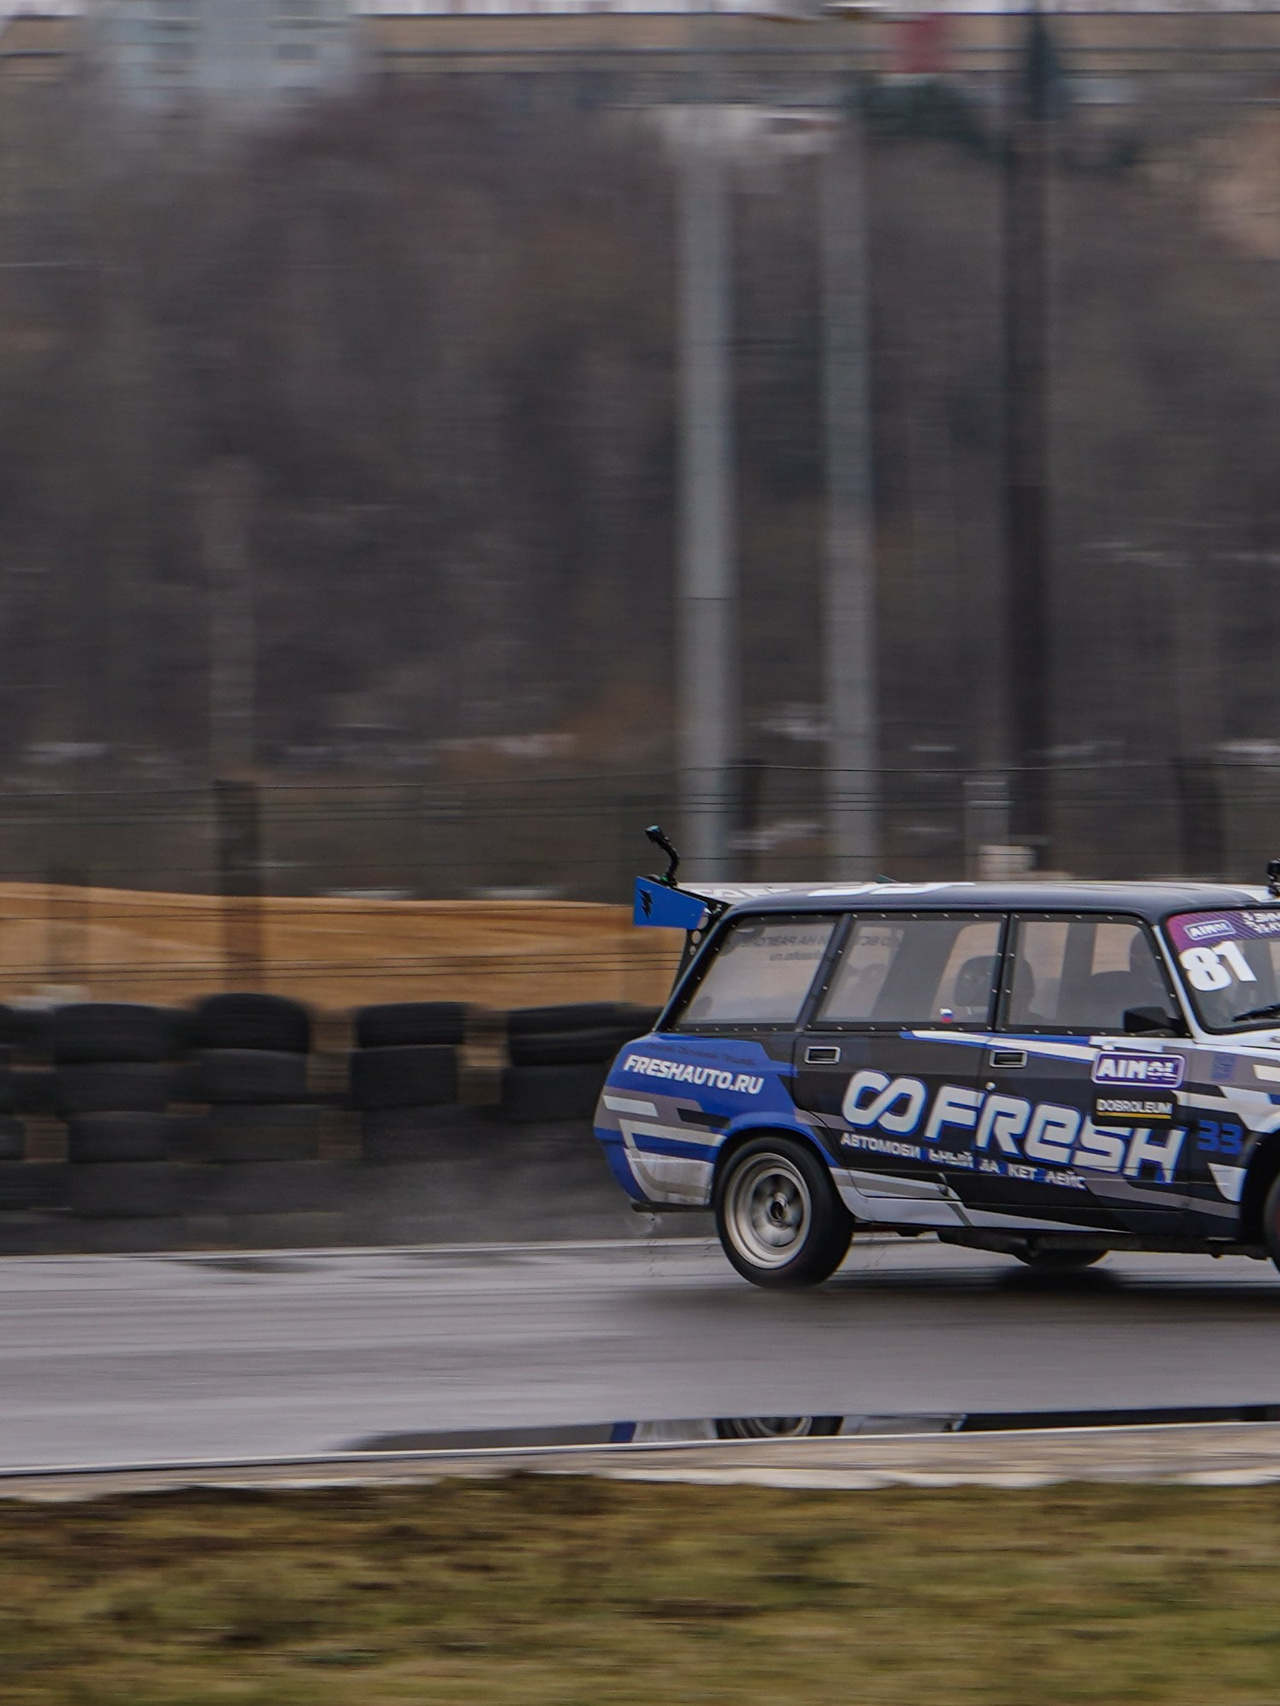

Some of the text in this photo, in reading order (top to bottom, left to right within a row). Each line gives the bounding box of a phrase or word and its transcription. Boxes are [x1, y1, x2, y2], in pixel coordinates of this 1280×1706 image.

[1180, 941, 1257, 991] 81
[623, 1054, 765, 1094] FRESHAUTO.RU
[1097, 1058, 1178, 1080] AIMOL
[1096, 1098, 1173, 1115] DOBROLEUM
[1196, 1119, 1243, 1155] 33
